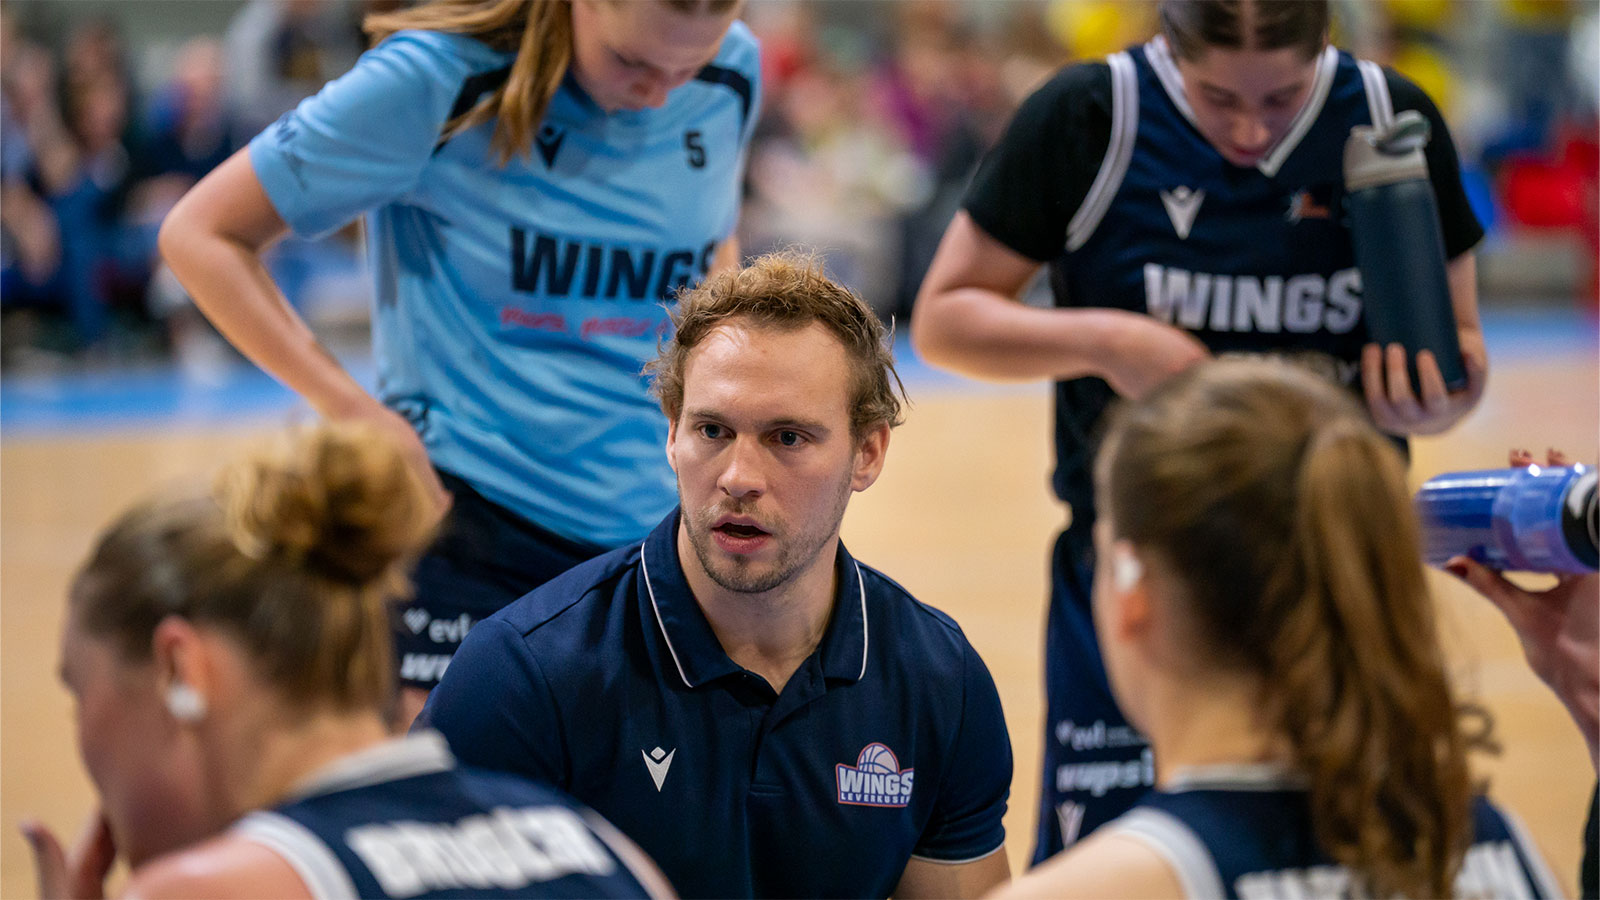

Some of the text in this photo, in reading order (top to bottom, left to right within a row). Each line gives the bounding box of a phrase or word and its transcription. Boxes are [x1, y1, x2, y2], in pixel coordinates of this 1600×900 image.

[685, 131, 706, 169] 5
[1143, 262, 1363, 334] WINGS
[839, 766, 914, 796] WINGS
